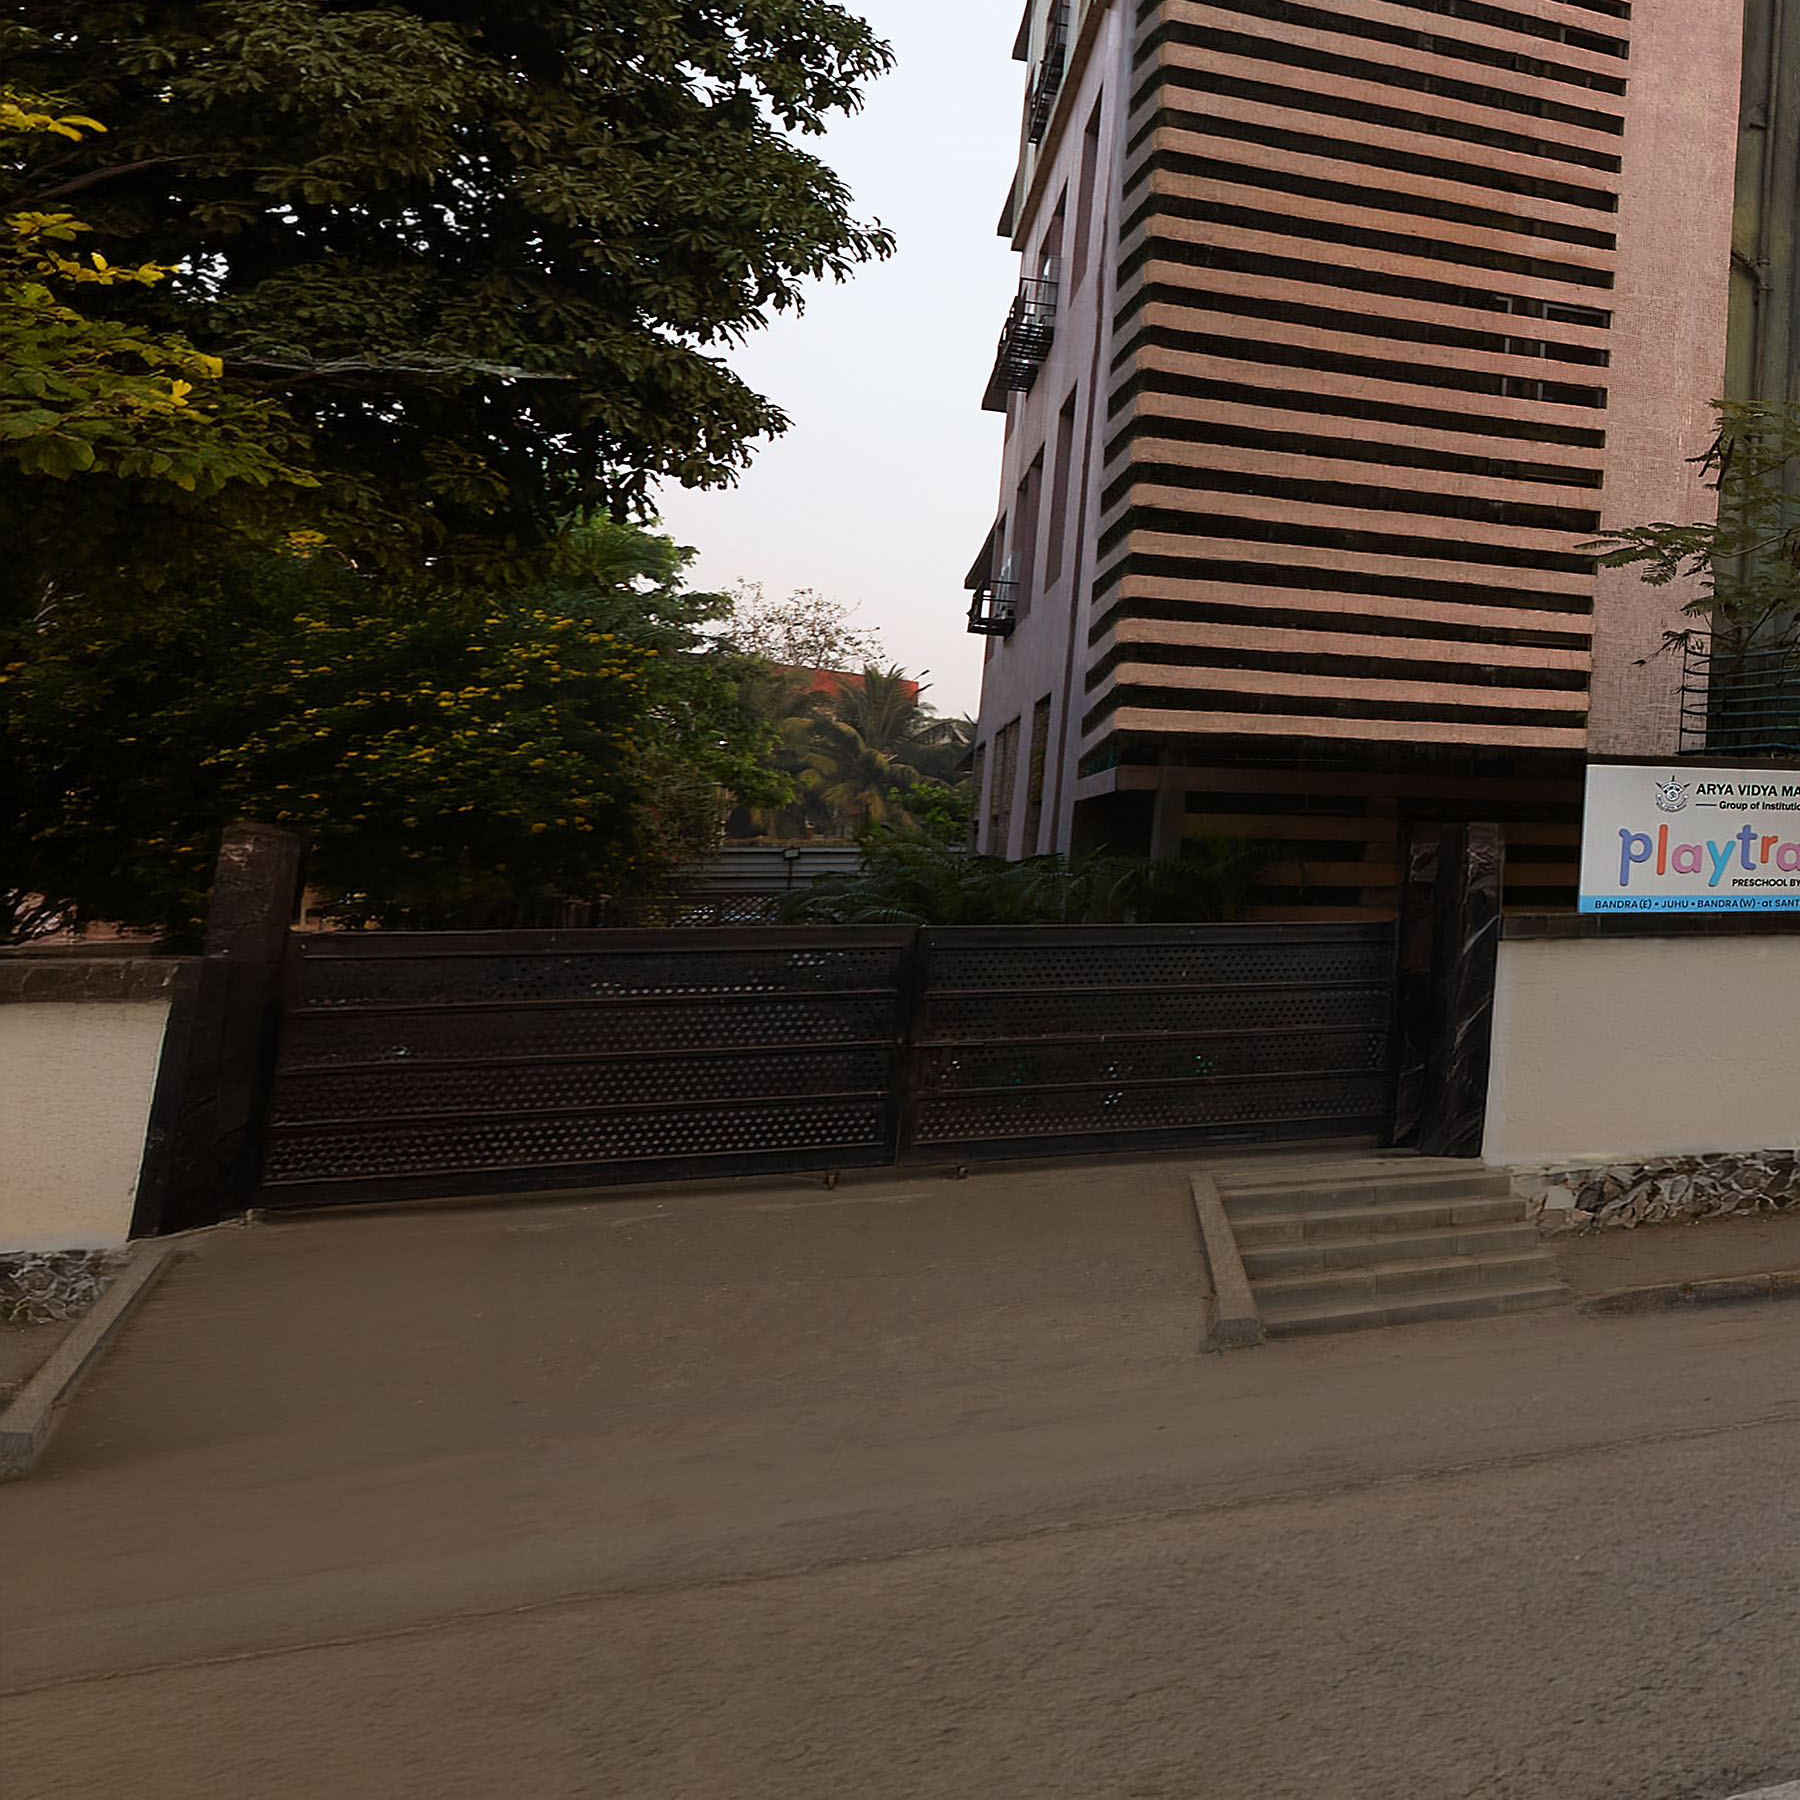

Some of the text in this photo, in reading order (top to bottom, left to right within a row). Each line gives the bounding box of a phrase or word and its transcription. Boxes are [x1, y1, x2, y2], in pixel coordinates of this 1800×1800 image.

[1696, 783, 1734, 796] ARYA
[1738, 784, 1777, 797] VIDYA
[1719, 801, 1748, 811] Group
[1750, 801, 1760, 810] of
[1732, 878, 1788, 887] PRESCHOOL
[1790, 879, 1800, 887] BY
[1661, 900, 1689, 908] JUHU
